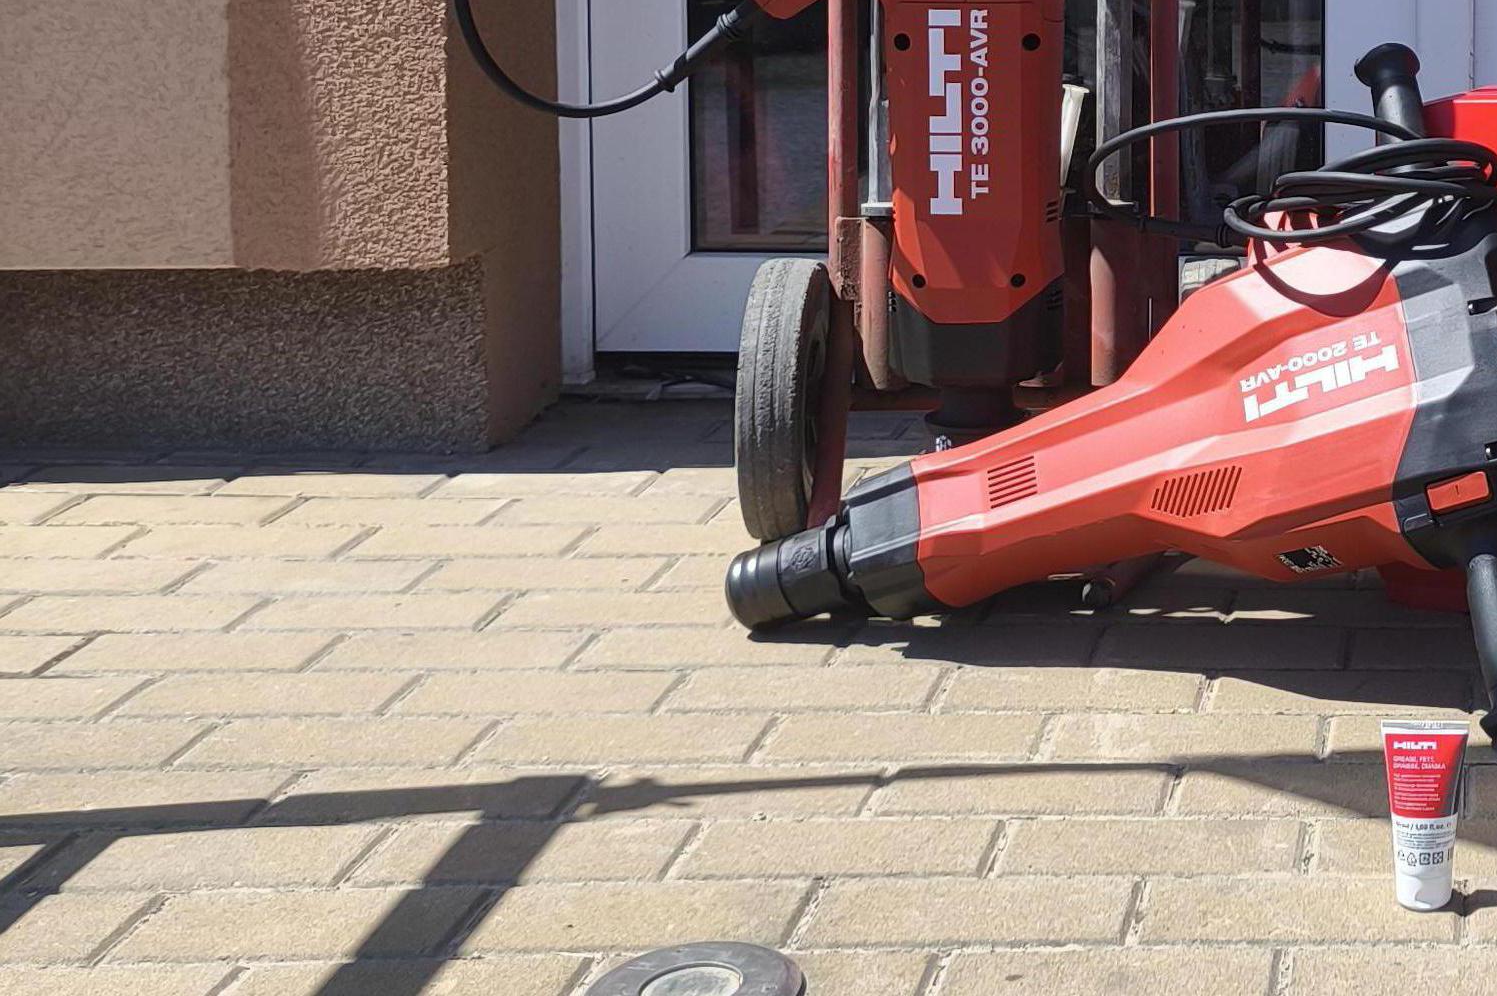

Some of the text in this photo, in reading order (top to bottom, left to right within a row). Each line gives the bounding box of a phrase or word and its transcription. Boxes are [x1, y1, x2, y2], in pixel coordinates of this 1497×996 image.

[928, 9, 963, 215] HILTI
[970, 9, 990, 199] TE 3000-AVR
[1239, 331, 1382, 393] TE 2000-AVR
[1243, 344, 1400, 423] HILTI
